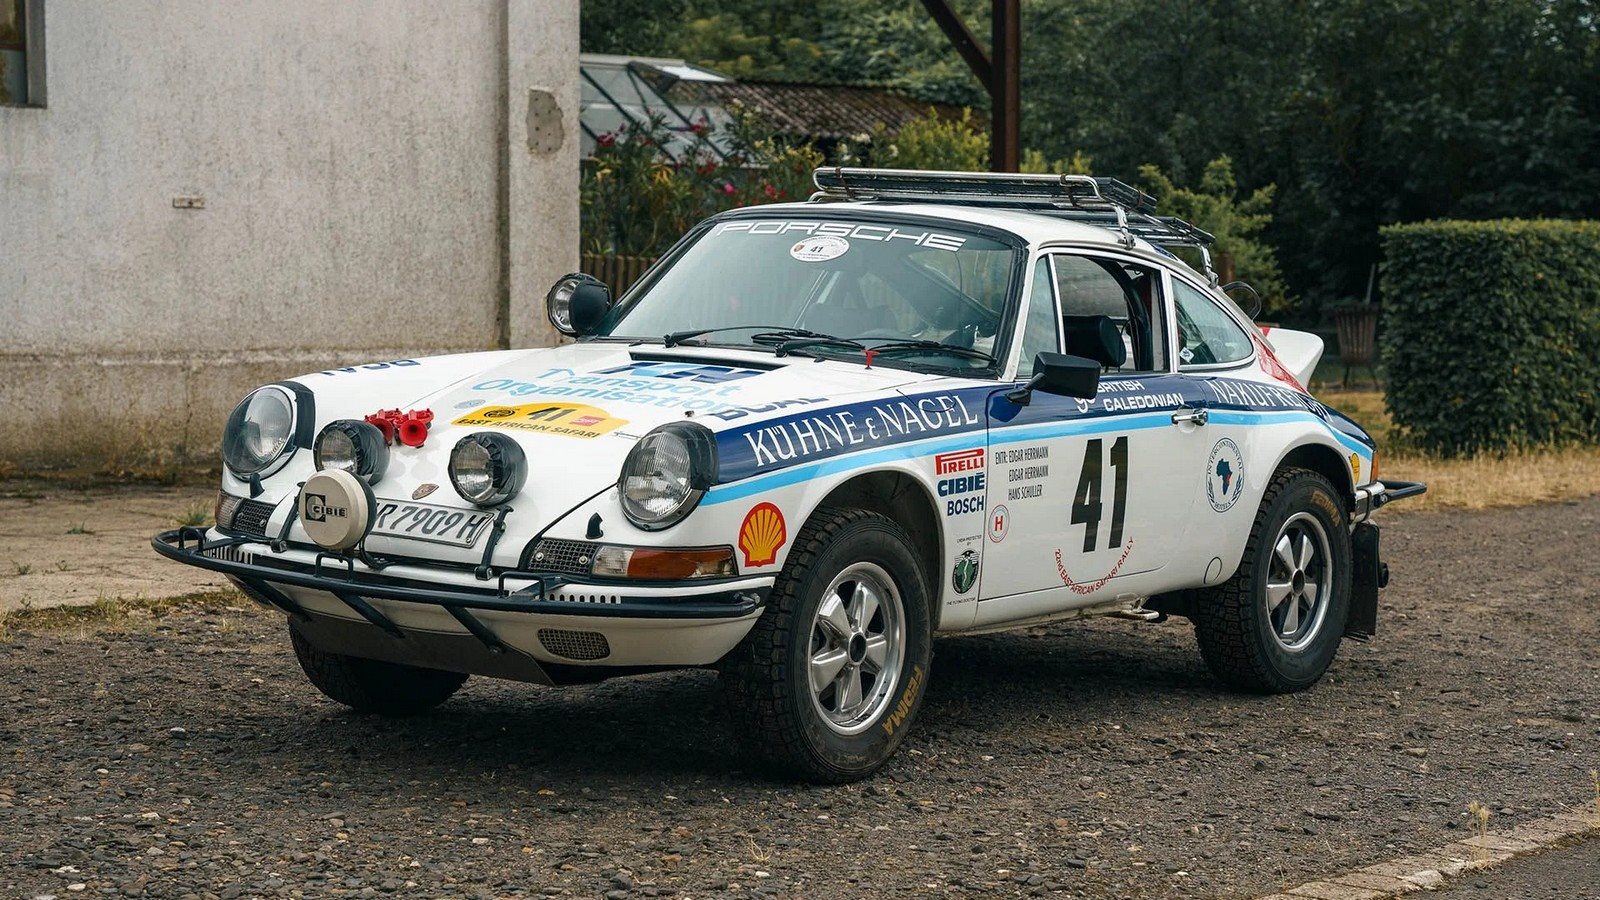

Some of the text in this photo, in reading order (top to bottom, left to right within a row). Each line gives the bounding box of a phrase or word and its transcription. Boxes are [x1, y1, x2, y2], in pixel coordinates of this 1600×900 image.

[717, 221, 968, 251] PORSCHE
[536, 368, 743, 398] Transport
[1103, 392, 1185, 412] CALEDONIAN
[526, 406, 577, 421] 41
[457, 418, 601, 438] EAST AFRICAN SAFARI
[743, 411, 864, 467] KÜHNE
[872, 395, 979, 438] NAGEL
[935, 448, 985, 476] PIRELLI
[1008, 448, 1024, 463] EDGAR
[1024, 446, 1049, 461] HERRMANN
[1008, 465, 1049, 482] EDGAR HERRMANN
[1008, 487, 1021, 501] HANS
[1071, 436, 1129, 553] 41
[947, 495, 985, 517] BOSCH
[994, 516, 1004, 531] H
[1060, 570, 1074, 587] EAST
[1095, 567, 1119, 590] SAFARI
[1117, 536, 1134, 569] RALLY
[882, 665, 924, 735] FEDIMA
